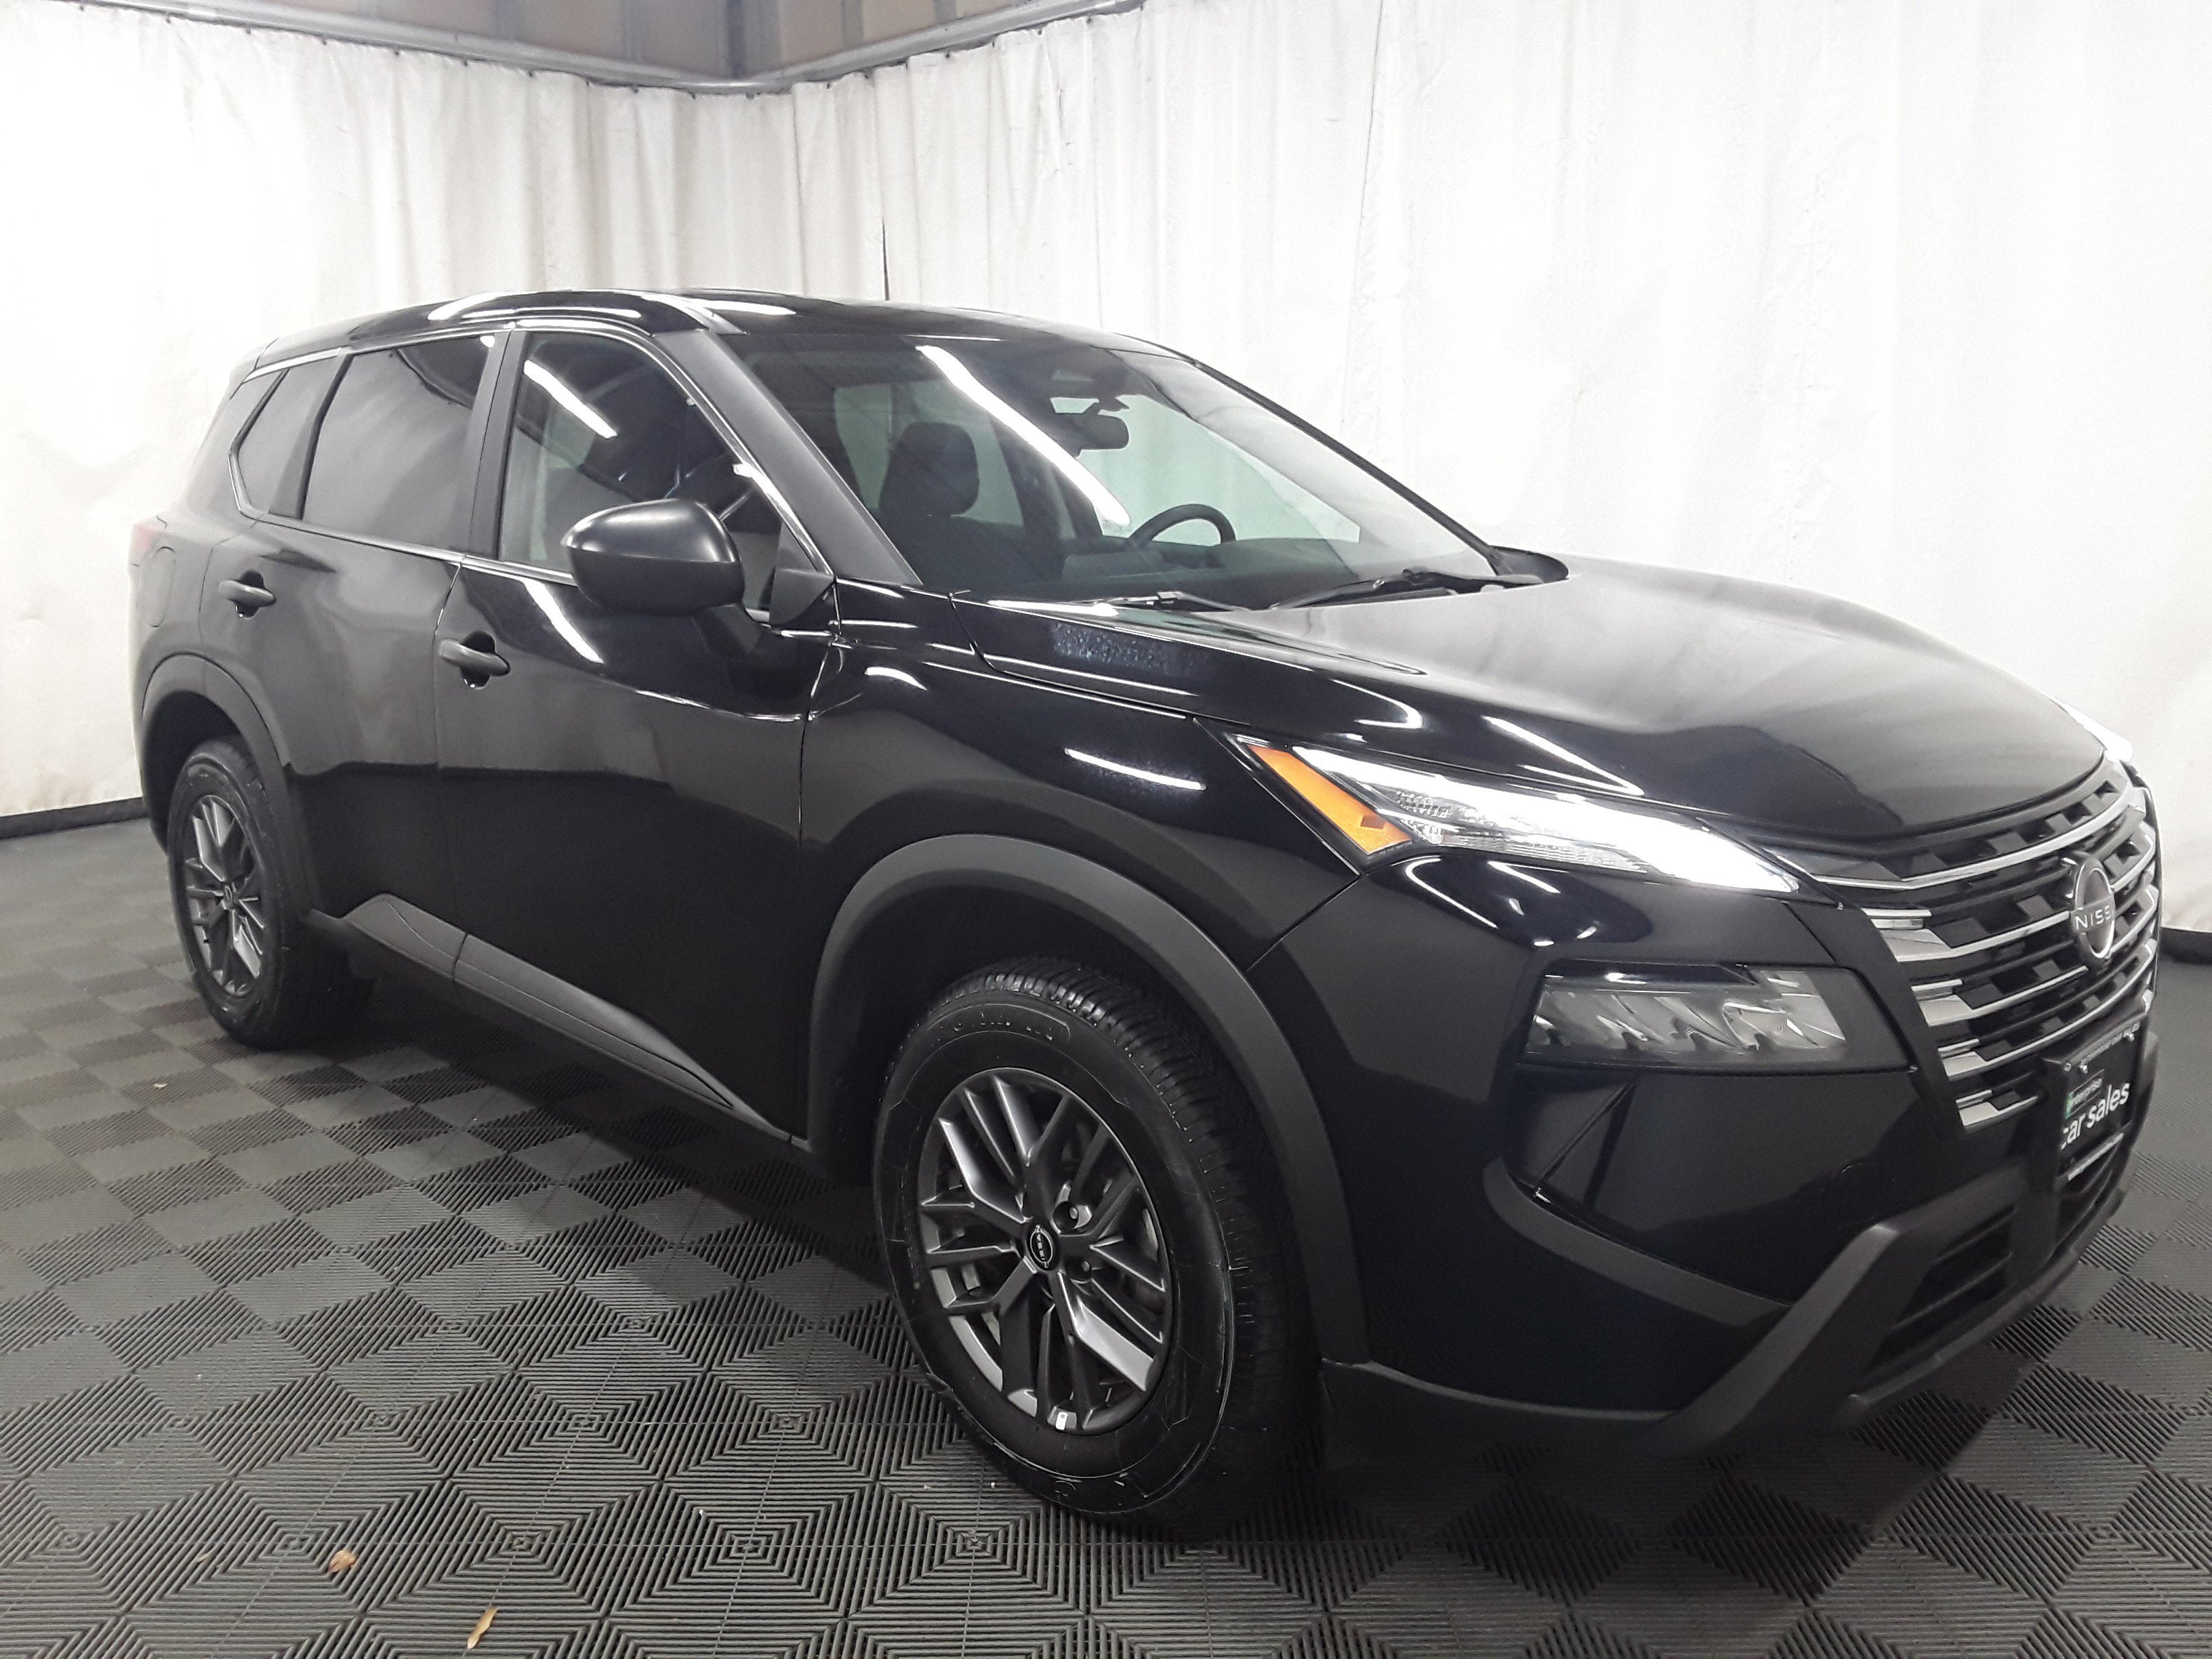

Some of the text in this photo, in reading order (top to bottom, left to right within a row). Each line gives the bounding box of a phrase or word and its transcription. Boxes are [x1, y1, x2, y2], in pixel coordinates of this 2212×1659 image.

[2075, 905, 2110, 930] NISS
[2086, 1082, 2130, 1128] sales
[1036, 1225, 1049, 1269] NISSAN
